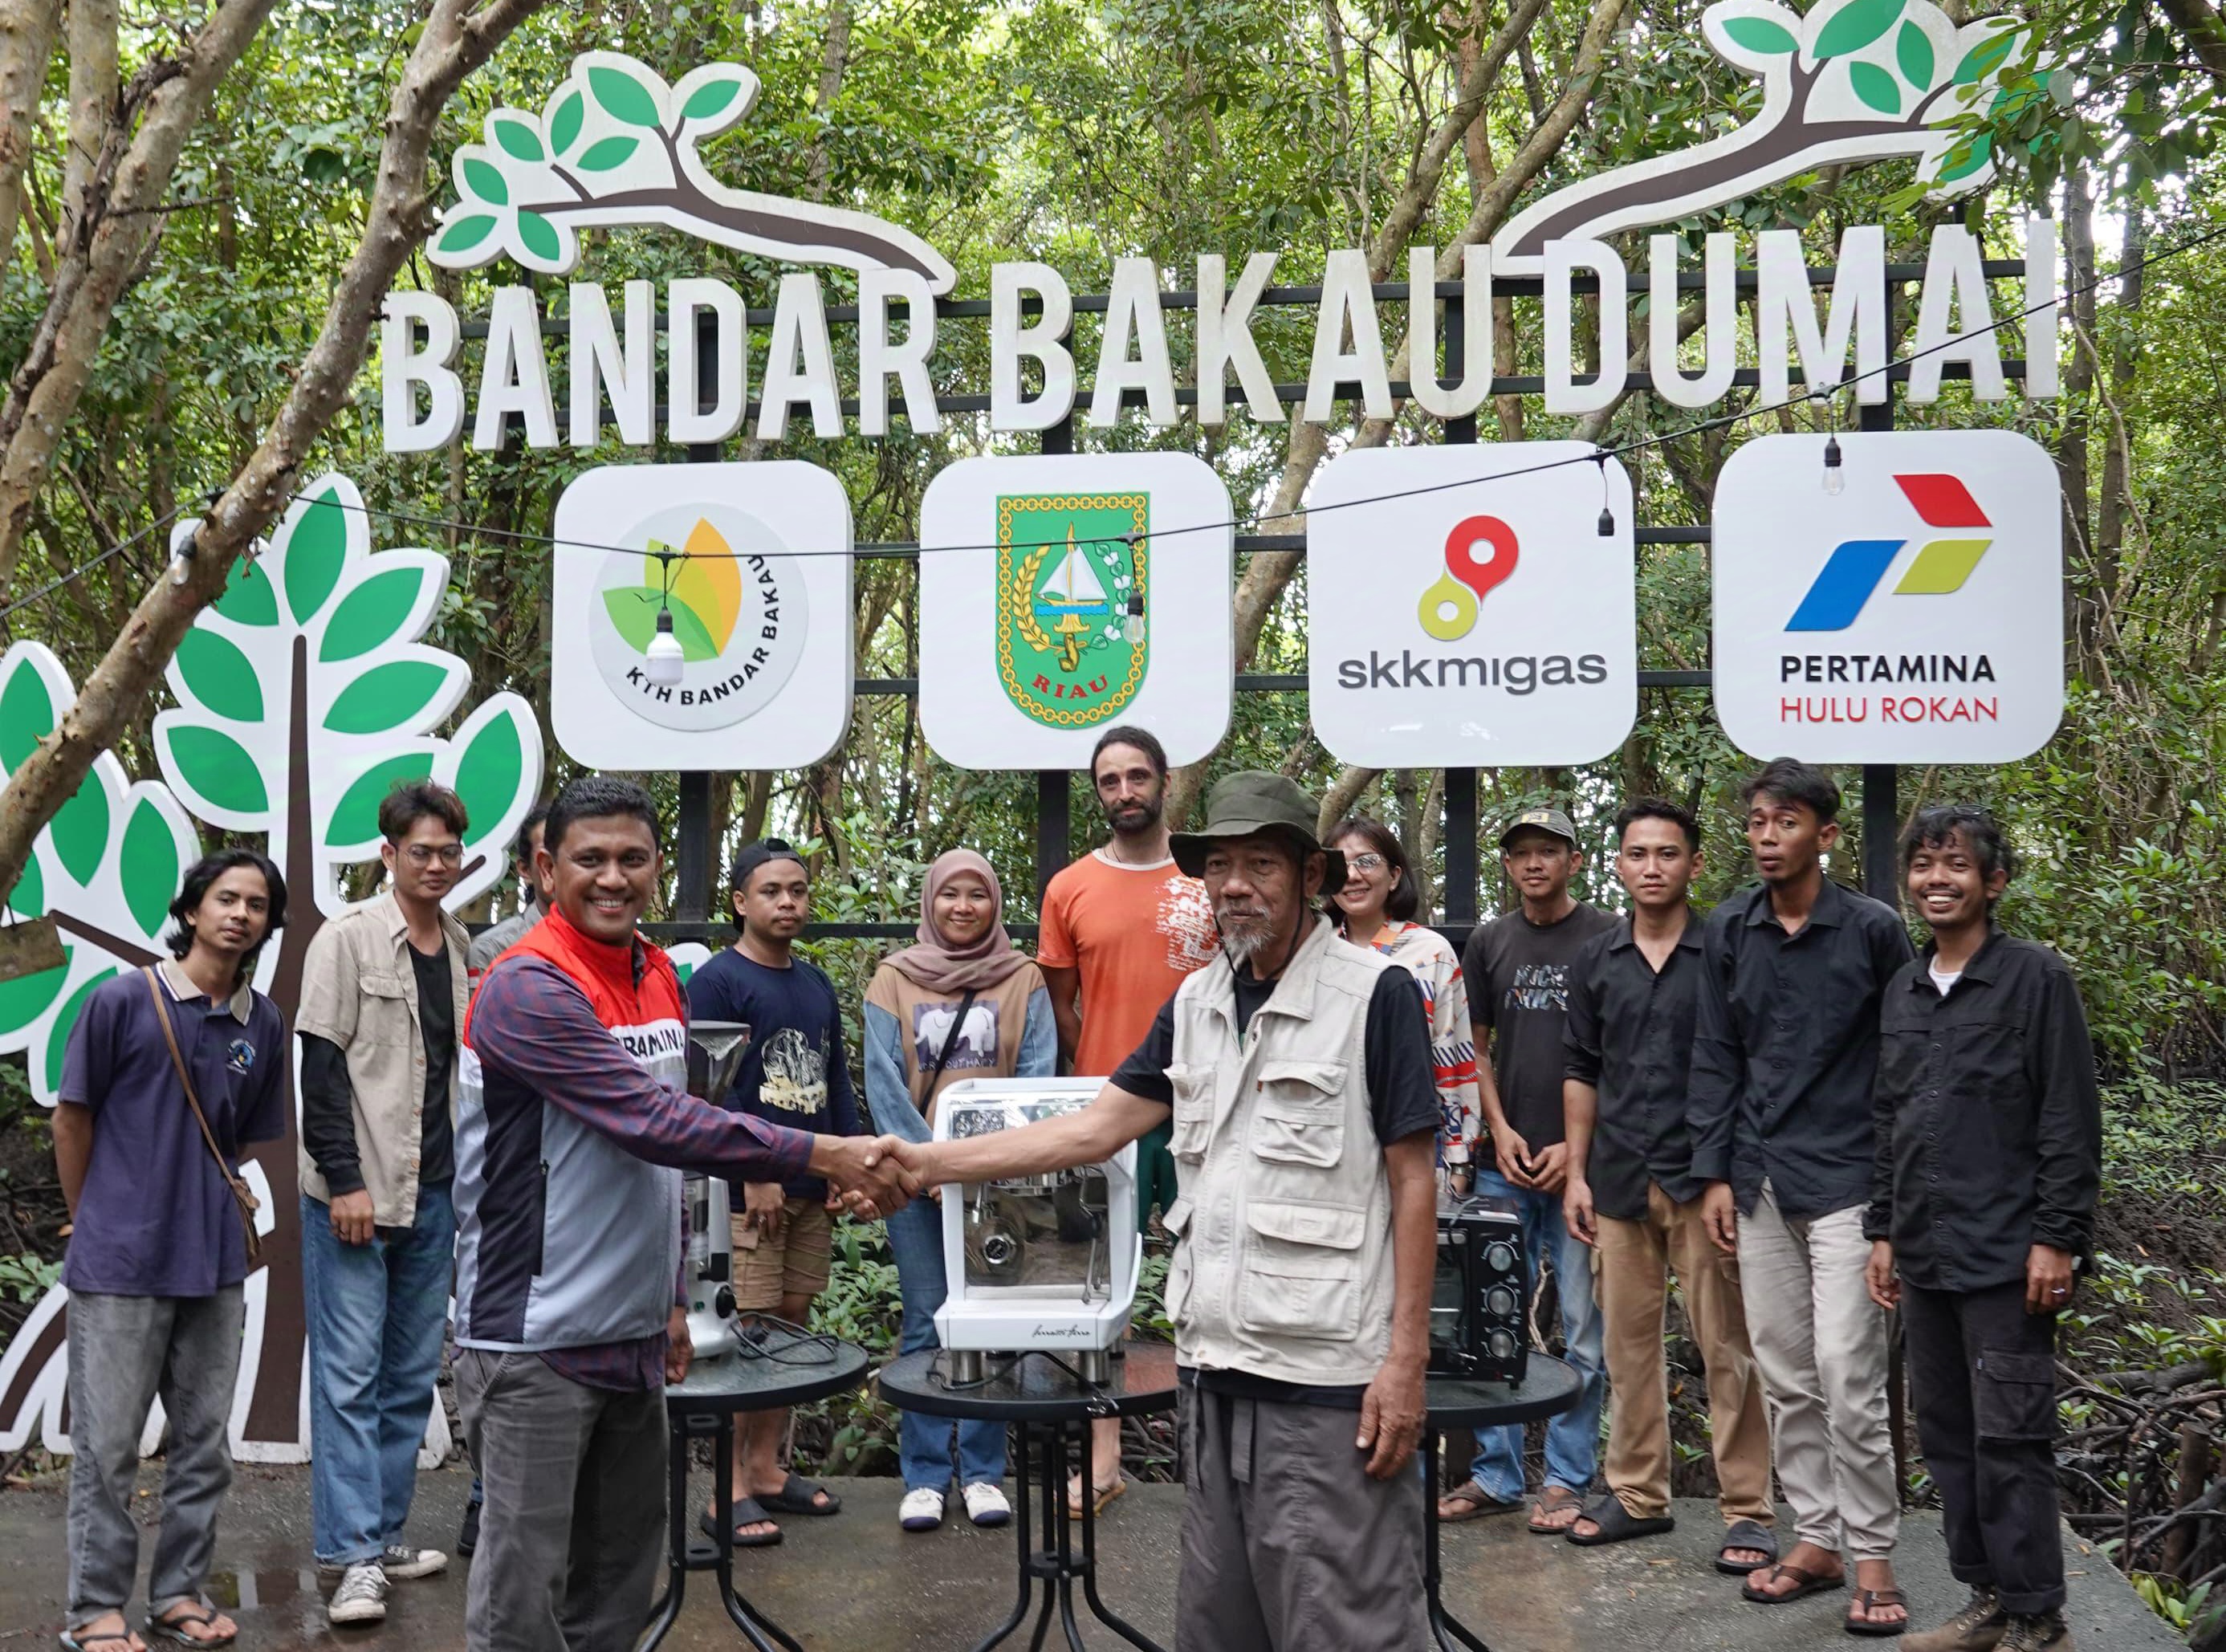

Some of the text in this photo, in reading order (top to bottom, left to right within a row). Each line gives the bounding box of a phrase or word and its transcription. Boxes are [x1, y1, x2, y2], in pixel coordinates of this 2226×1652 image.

[381, 218, 2059, 452] BANDAR BAKAU DUMAI
[625, 553, 780, 706] KTH BANDAR BAKAU
[1032, 673, 1109, 699] RIAU
[1337, 649, 1608, 696] skkmigas
[1780, 654, 1996, 682] PERTAMINA
[1780, 697, 1997, 722] HULU ROKAN
